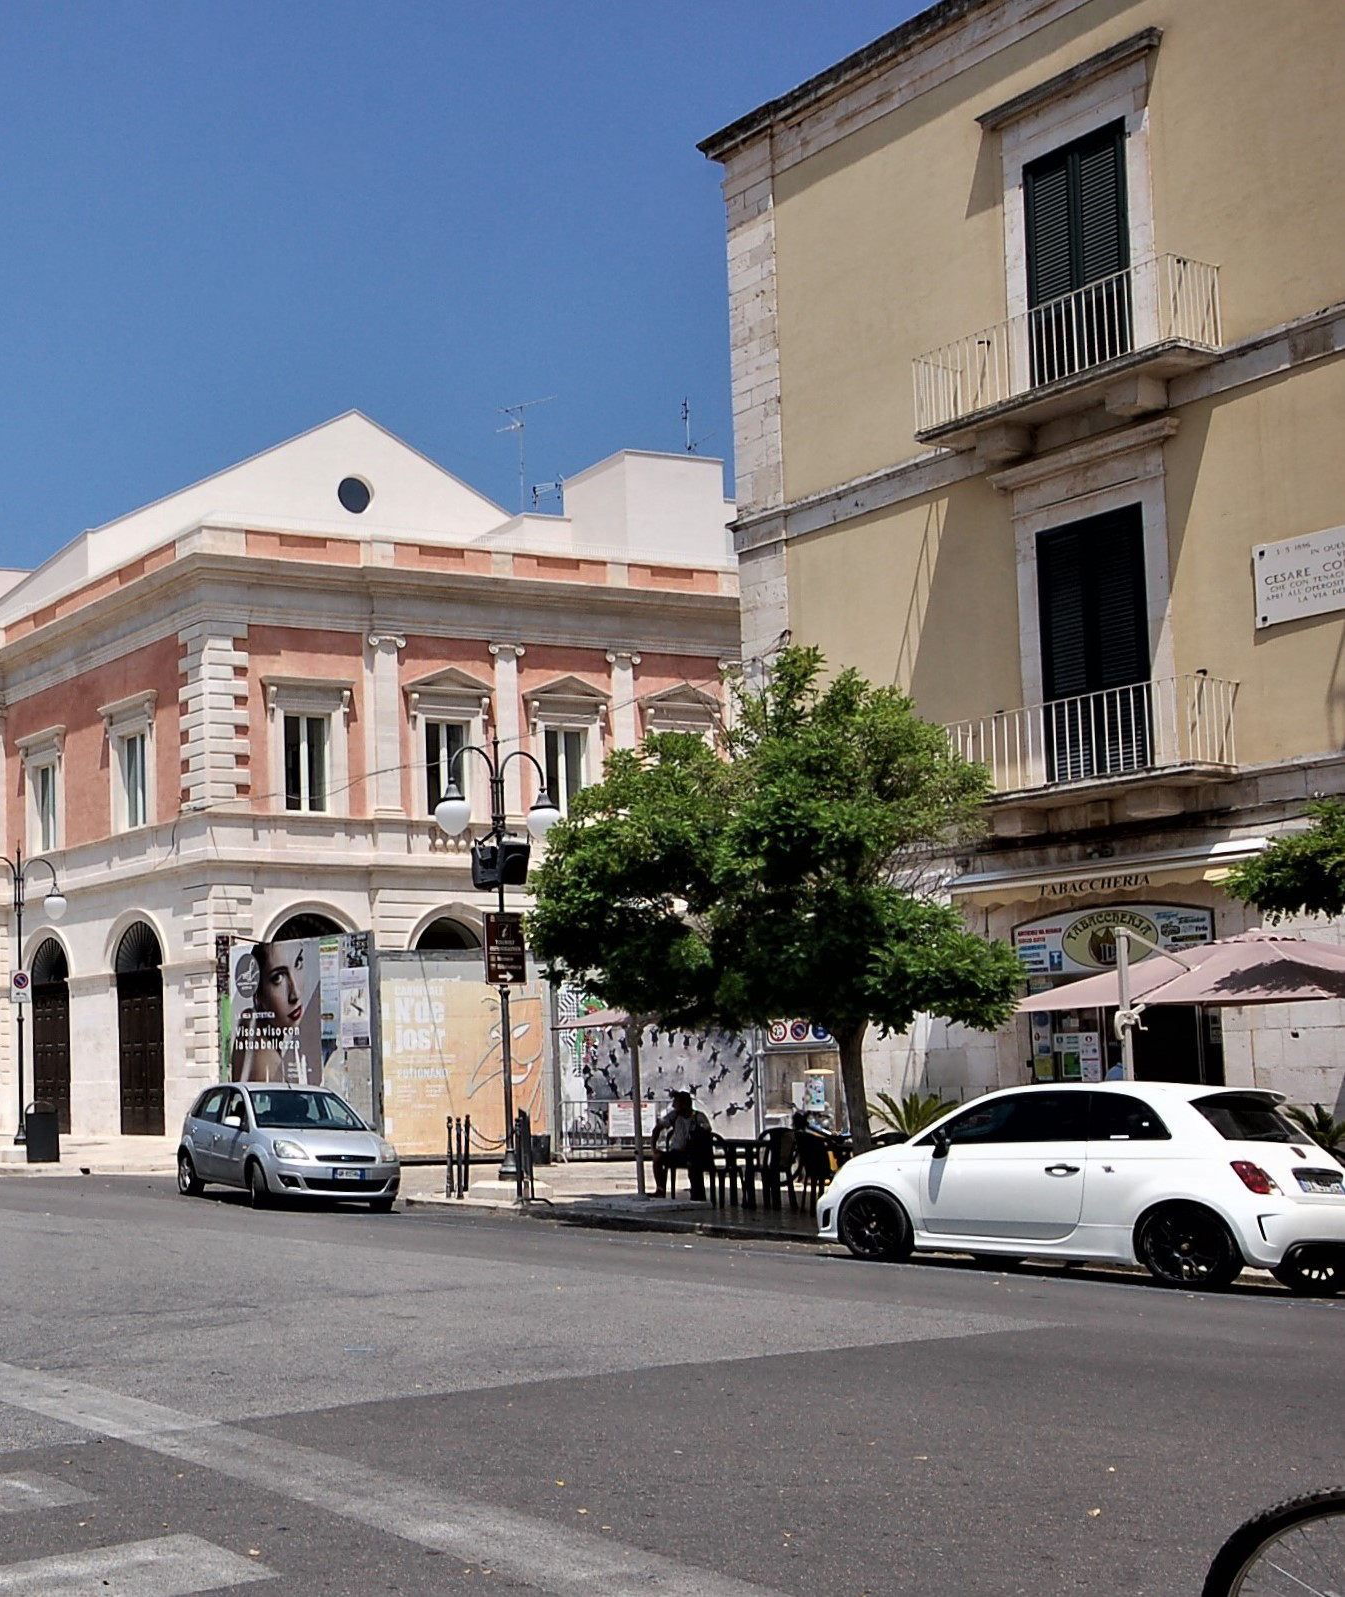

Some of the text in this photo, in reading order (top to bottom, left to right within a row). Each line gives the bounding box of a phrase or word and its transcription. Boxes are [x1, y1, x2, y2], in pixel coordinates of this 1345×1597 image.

[1264, 567, 1311, 585] CESARE
[1270, 584, 1285, 592] CHE
[1290, 579, 1308, 589] CON
[1038, 874, 1150, 896] TABACCHERIA
[1066, 912, 1152, 941] TABACCHERIA
[235, 1024, 300, 1037] Viso a viso con
[235, 1038, 300, 1050] la tua bellezza
